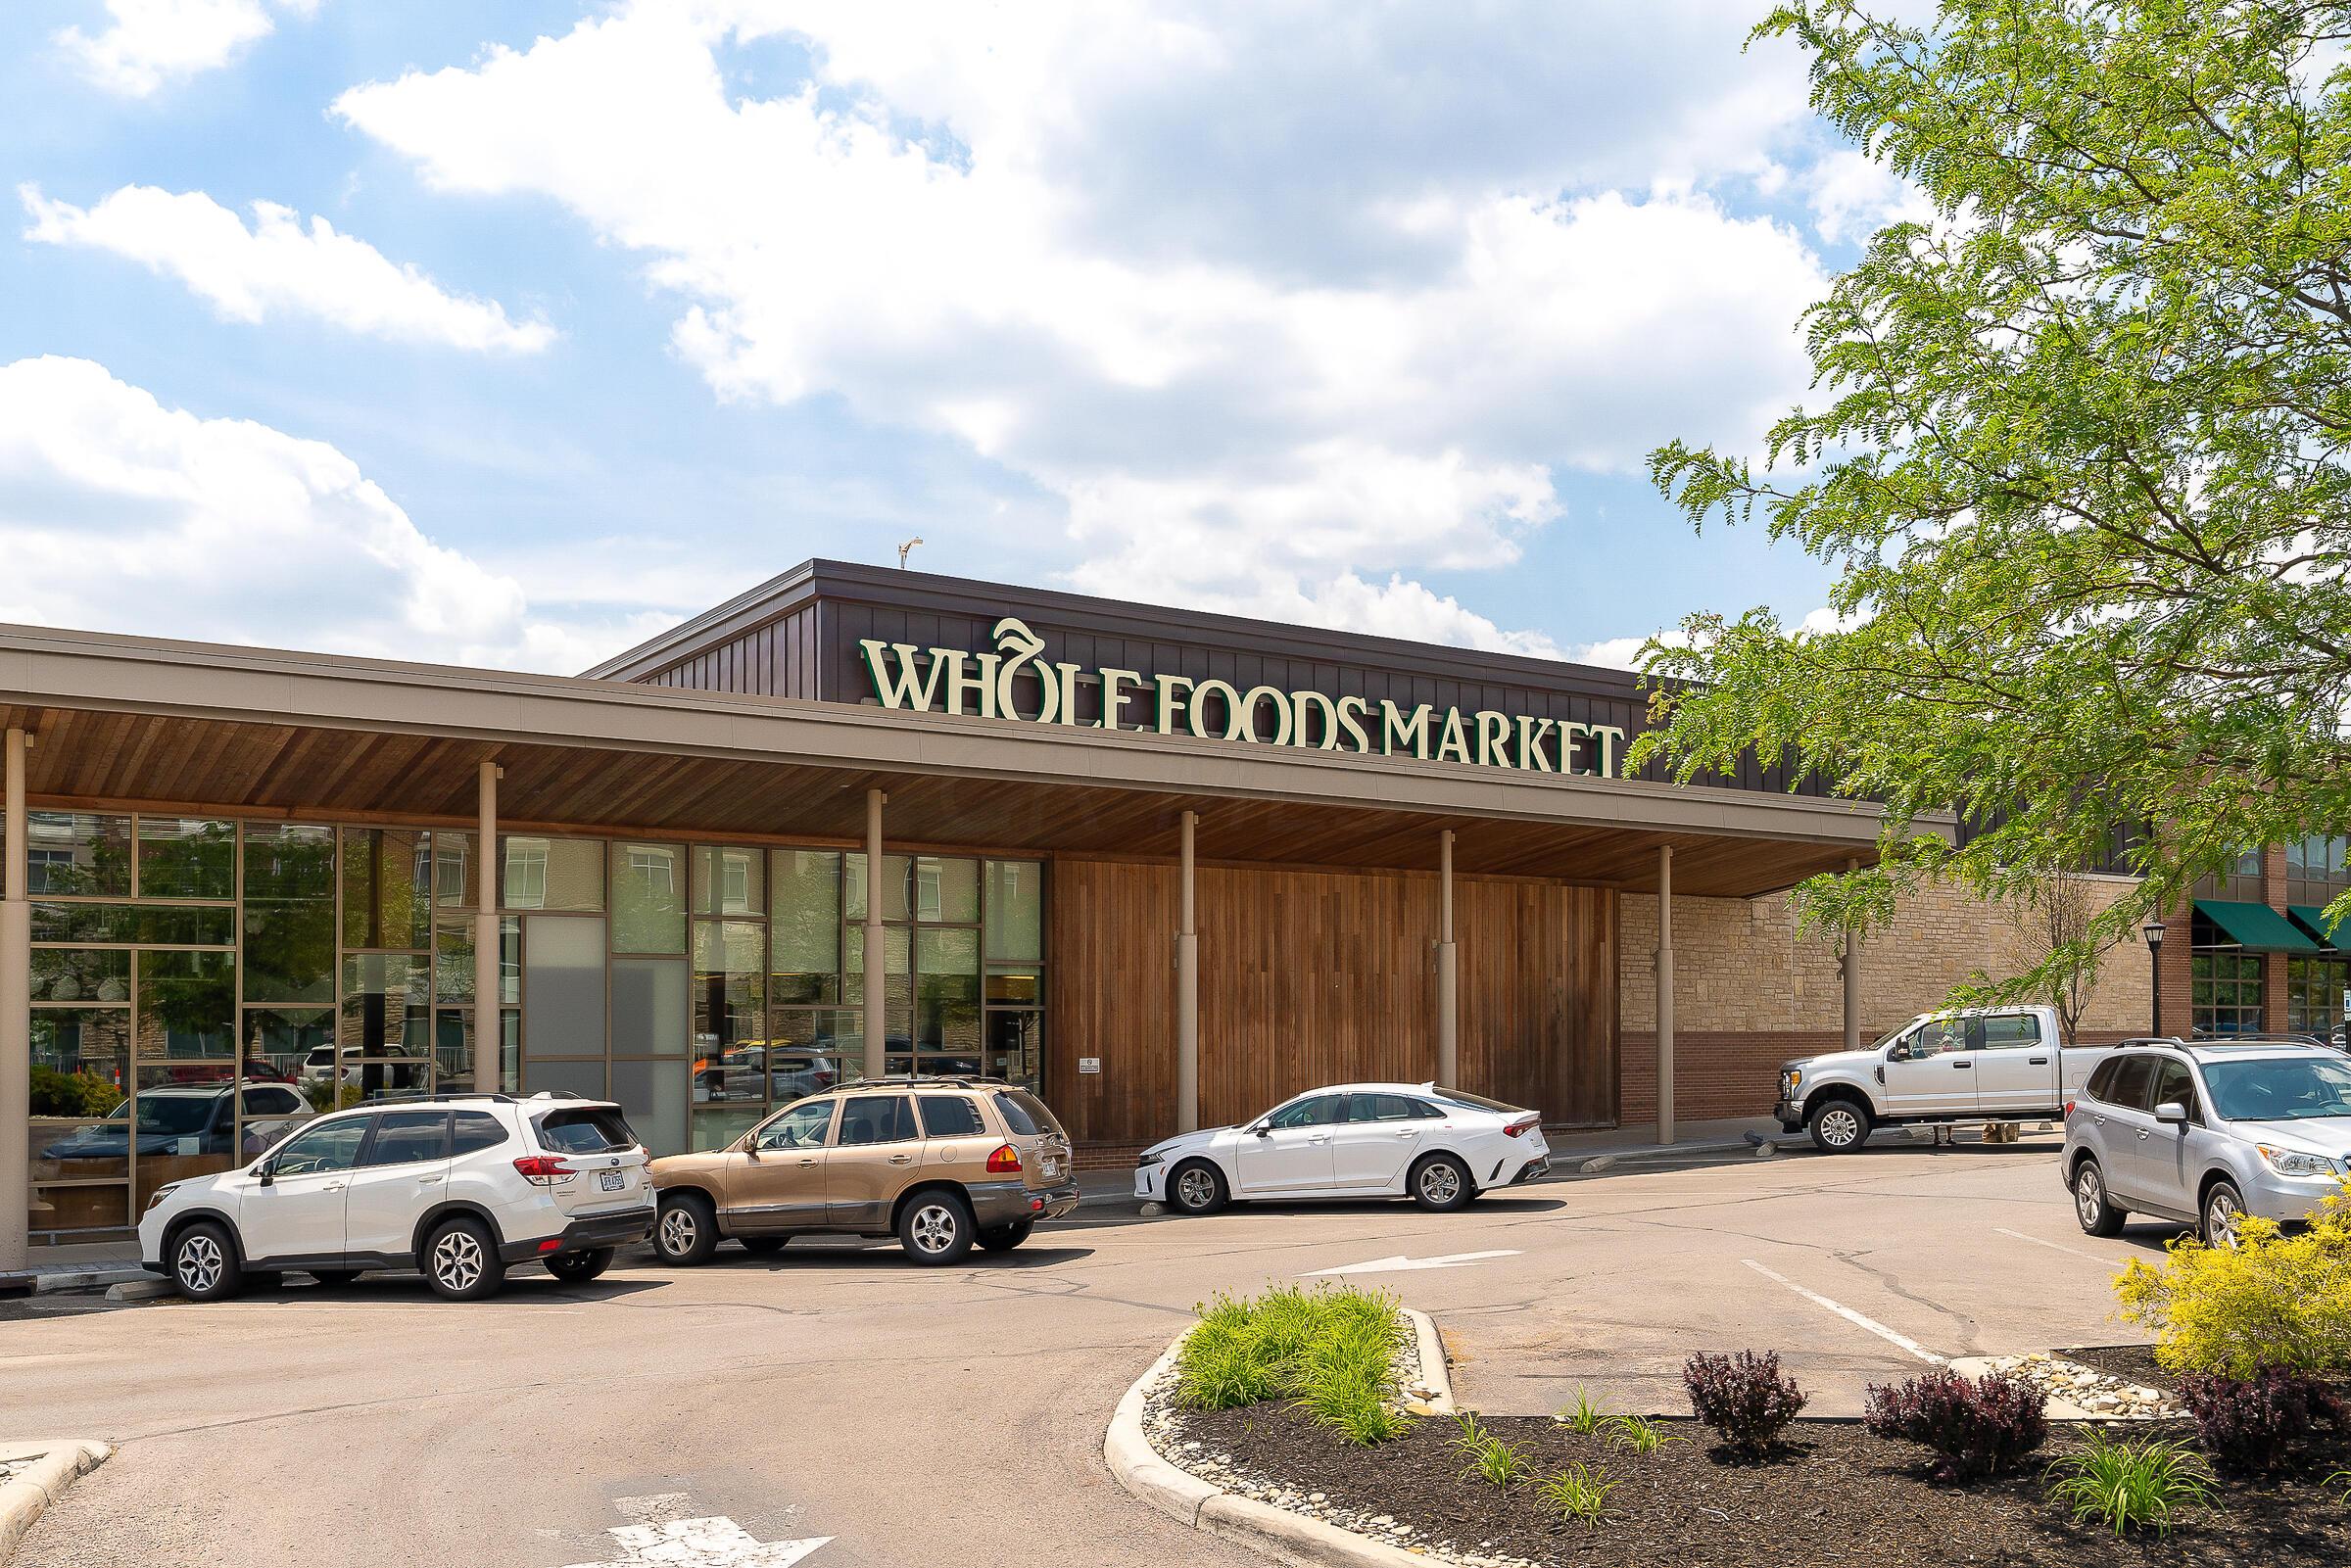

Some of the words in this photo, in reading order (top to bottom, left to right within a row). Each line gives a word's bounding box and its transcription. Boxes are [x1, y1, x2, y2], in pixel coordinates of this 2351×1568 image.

[858, 617, 1154, 733] WHOLE
[1154, 673, 1369, 754] FOODS
[1379, 698, 1626, 780] MARKET
